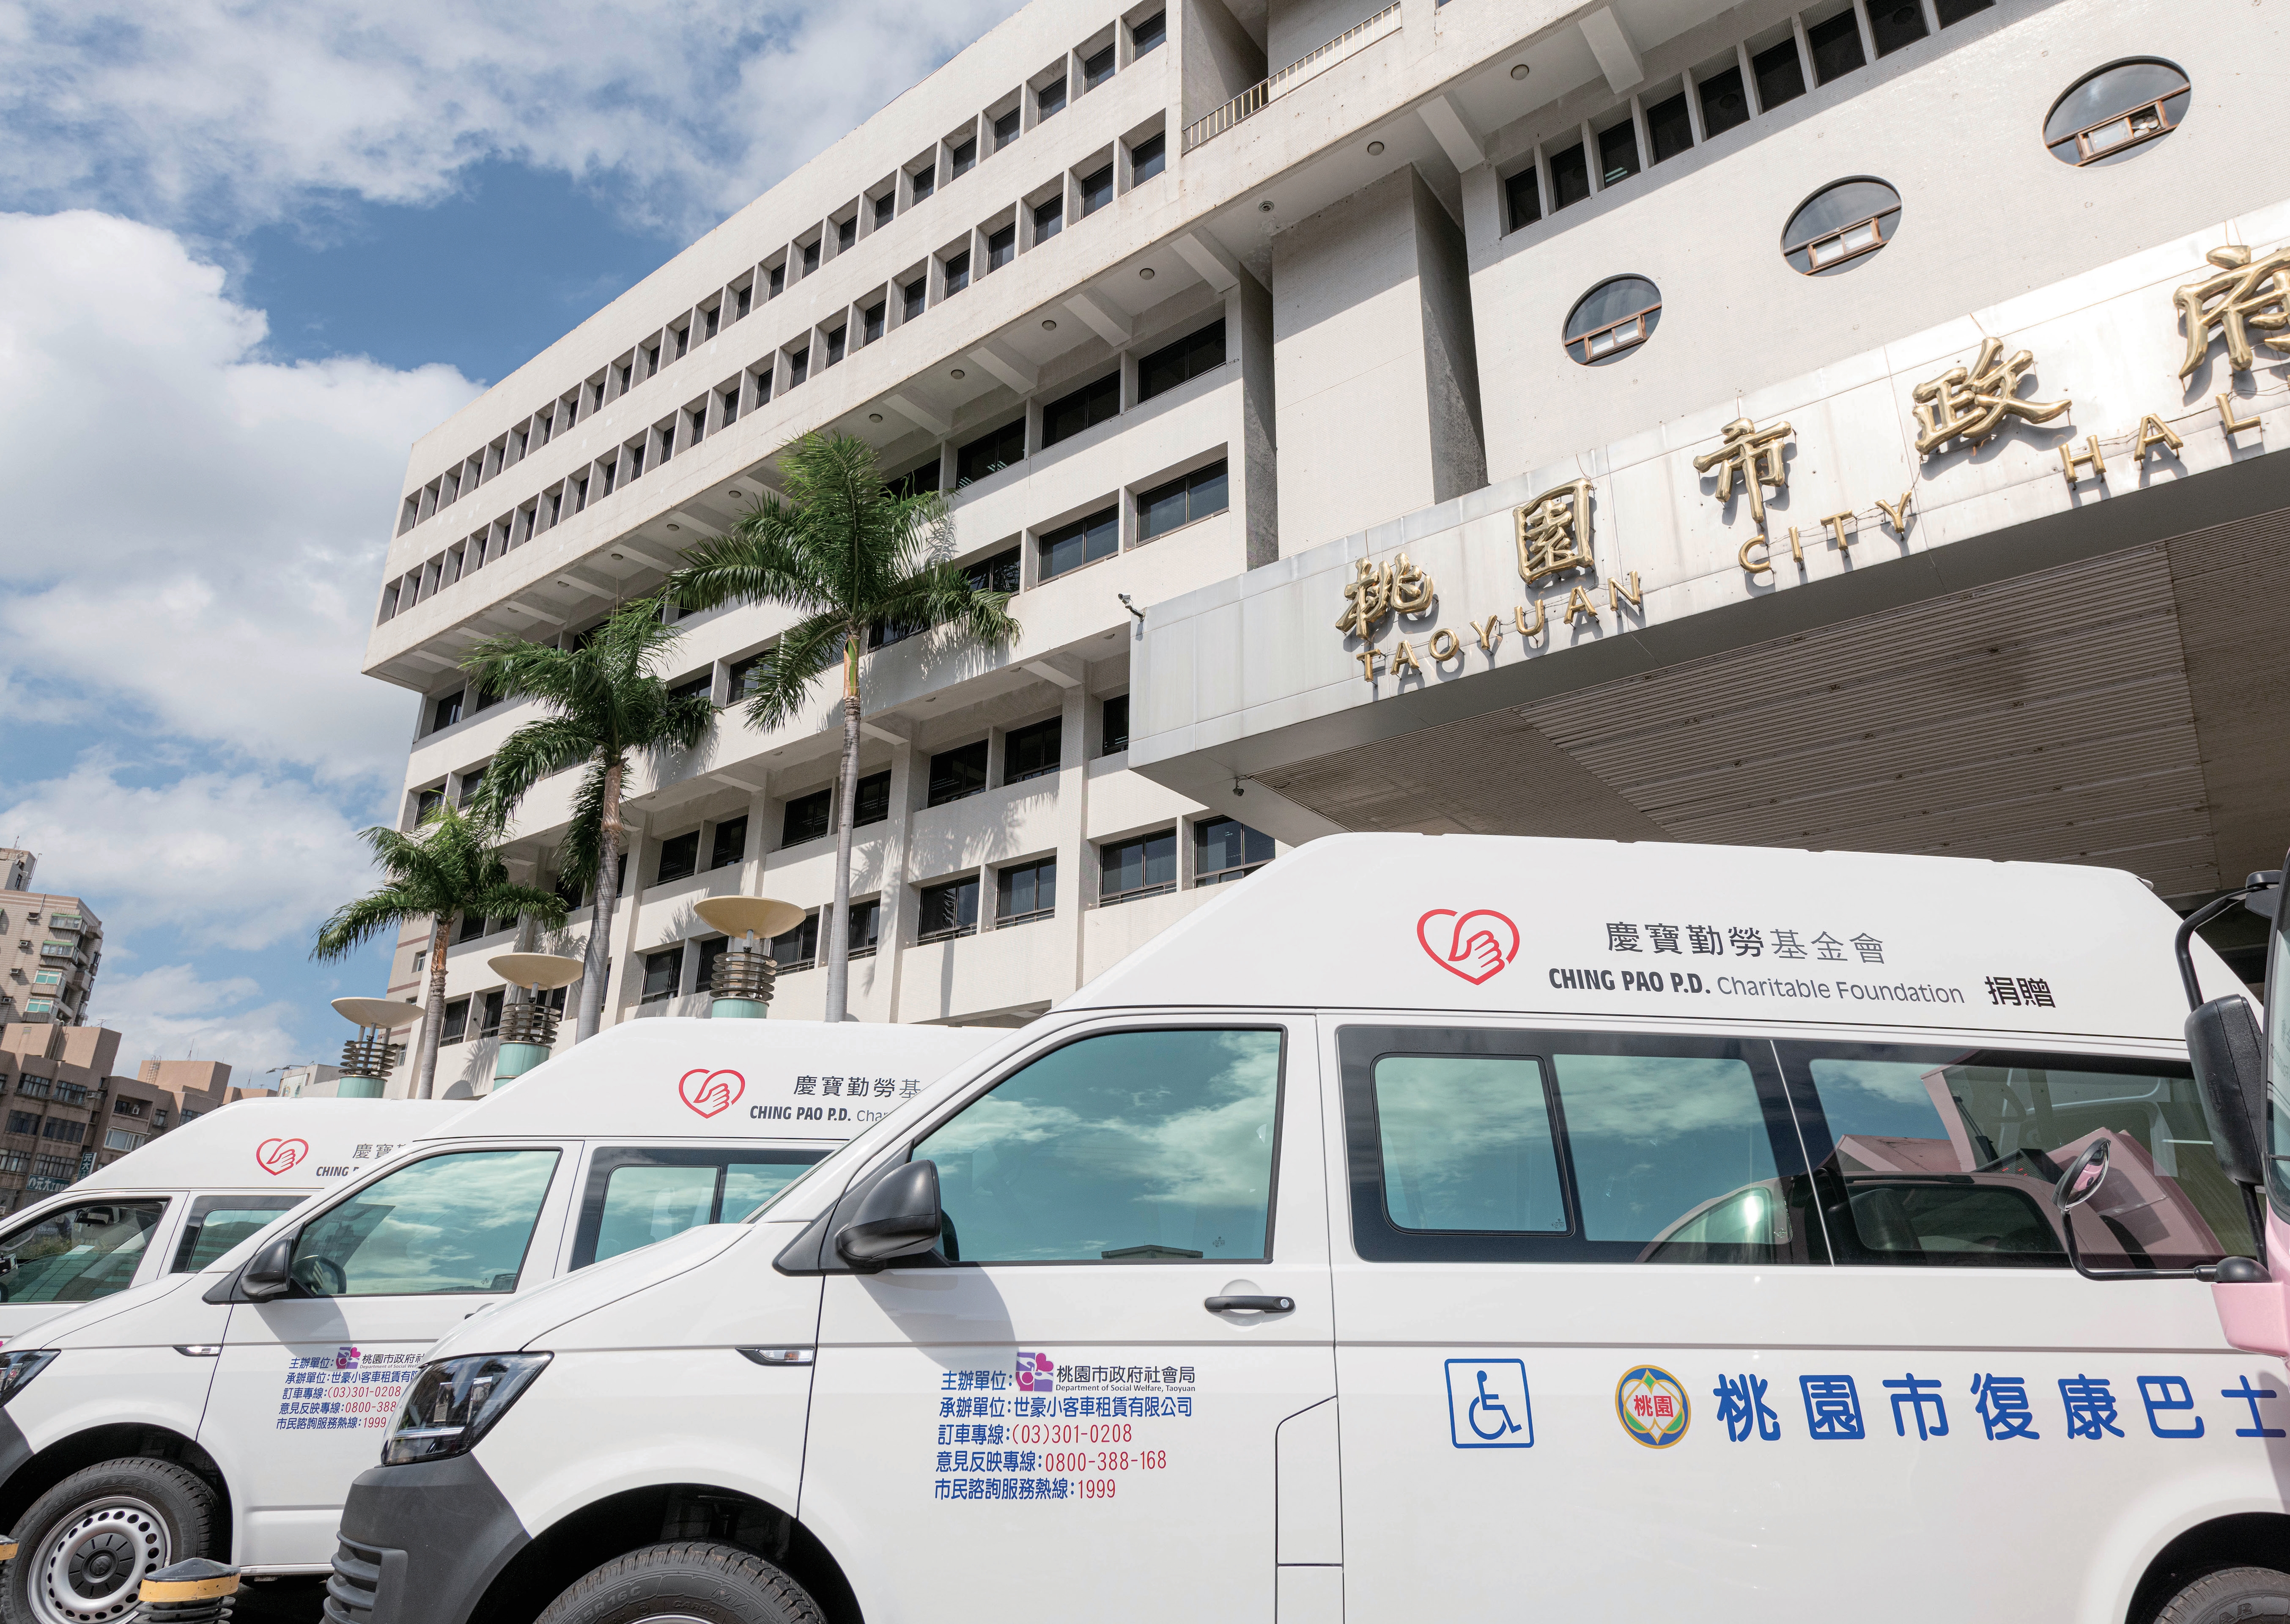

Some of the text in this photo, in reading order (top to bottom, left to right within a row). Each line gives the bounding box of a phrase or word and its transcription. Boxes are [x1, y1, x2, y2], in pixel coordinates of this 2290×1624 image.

[1335, 245, 2290, 639] 桃園市政府
[1356, 375, 2290, 682] TAOYUAN CITY HAL
[1606, 922, 1885, 965] 慶寶勤勞基金會
[1549, 968, 1965, 1003] CHING PAO P.D. Charitable Foundation
[1984, 976, 2057, 1009] 捐贈
[794, 1075, 921, 1099] 慶寶勤勞基
[750, 1105, 792, 1120] CHING
[796, 1107, 823, 1121] PAO
[827, 1107, 851, 1122] P.D.
[352, 1144, 406, 1159] 慶寶
[316, 1166, 349, 1177] CHING
[941, 1365, 1196, 1391] 主辦單位: 桃園市政府社會局
[1056, 1384, 1100, 1392] Department
[1133, 1384, 1163, 1393] Welfare,
[1165, 1385, 1196, 1393] Taoyuan
[1634, 1395, 1674, 1417] 桃園
[1713, 1373, 2287, 1440] 桃園市復康巴士
